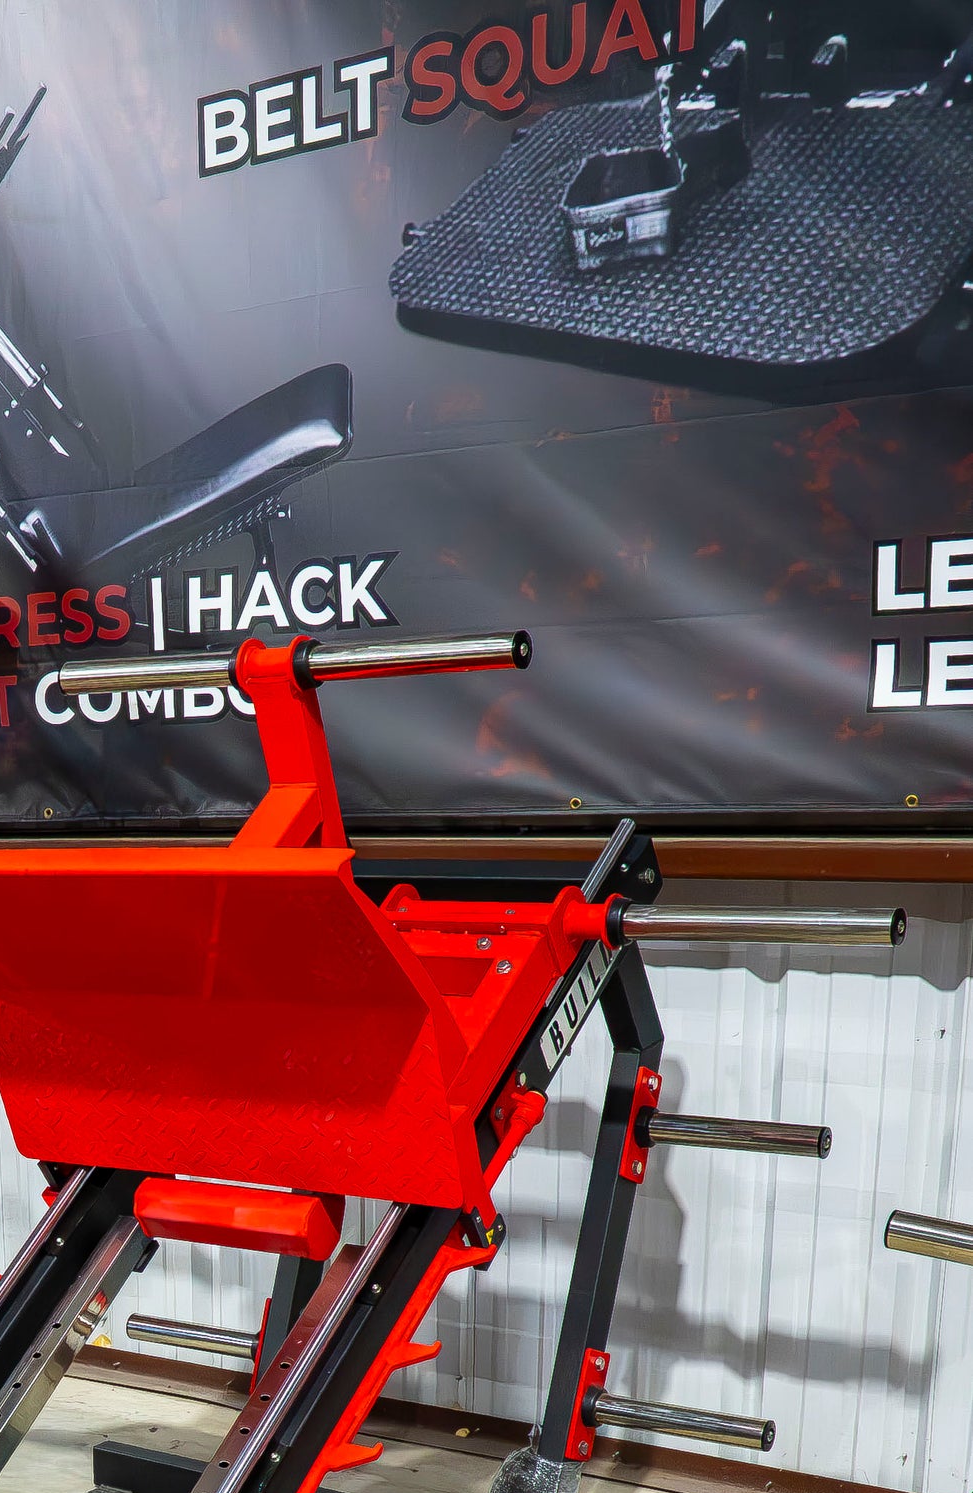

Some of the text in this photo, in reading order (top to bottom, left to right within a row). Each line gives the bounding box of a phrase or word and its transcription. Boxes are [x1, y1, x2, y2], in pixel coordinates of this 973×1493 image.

[203, 56, 388, 169] BELT
[188, 560, 387, 633] HACK
[35, 670, 256, 725] COMB
